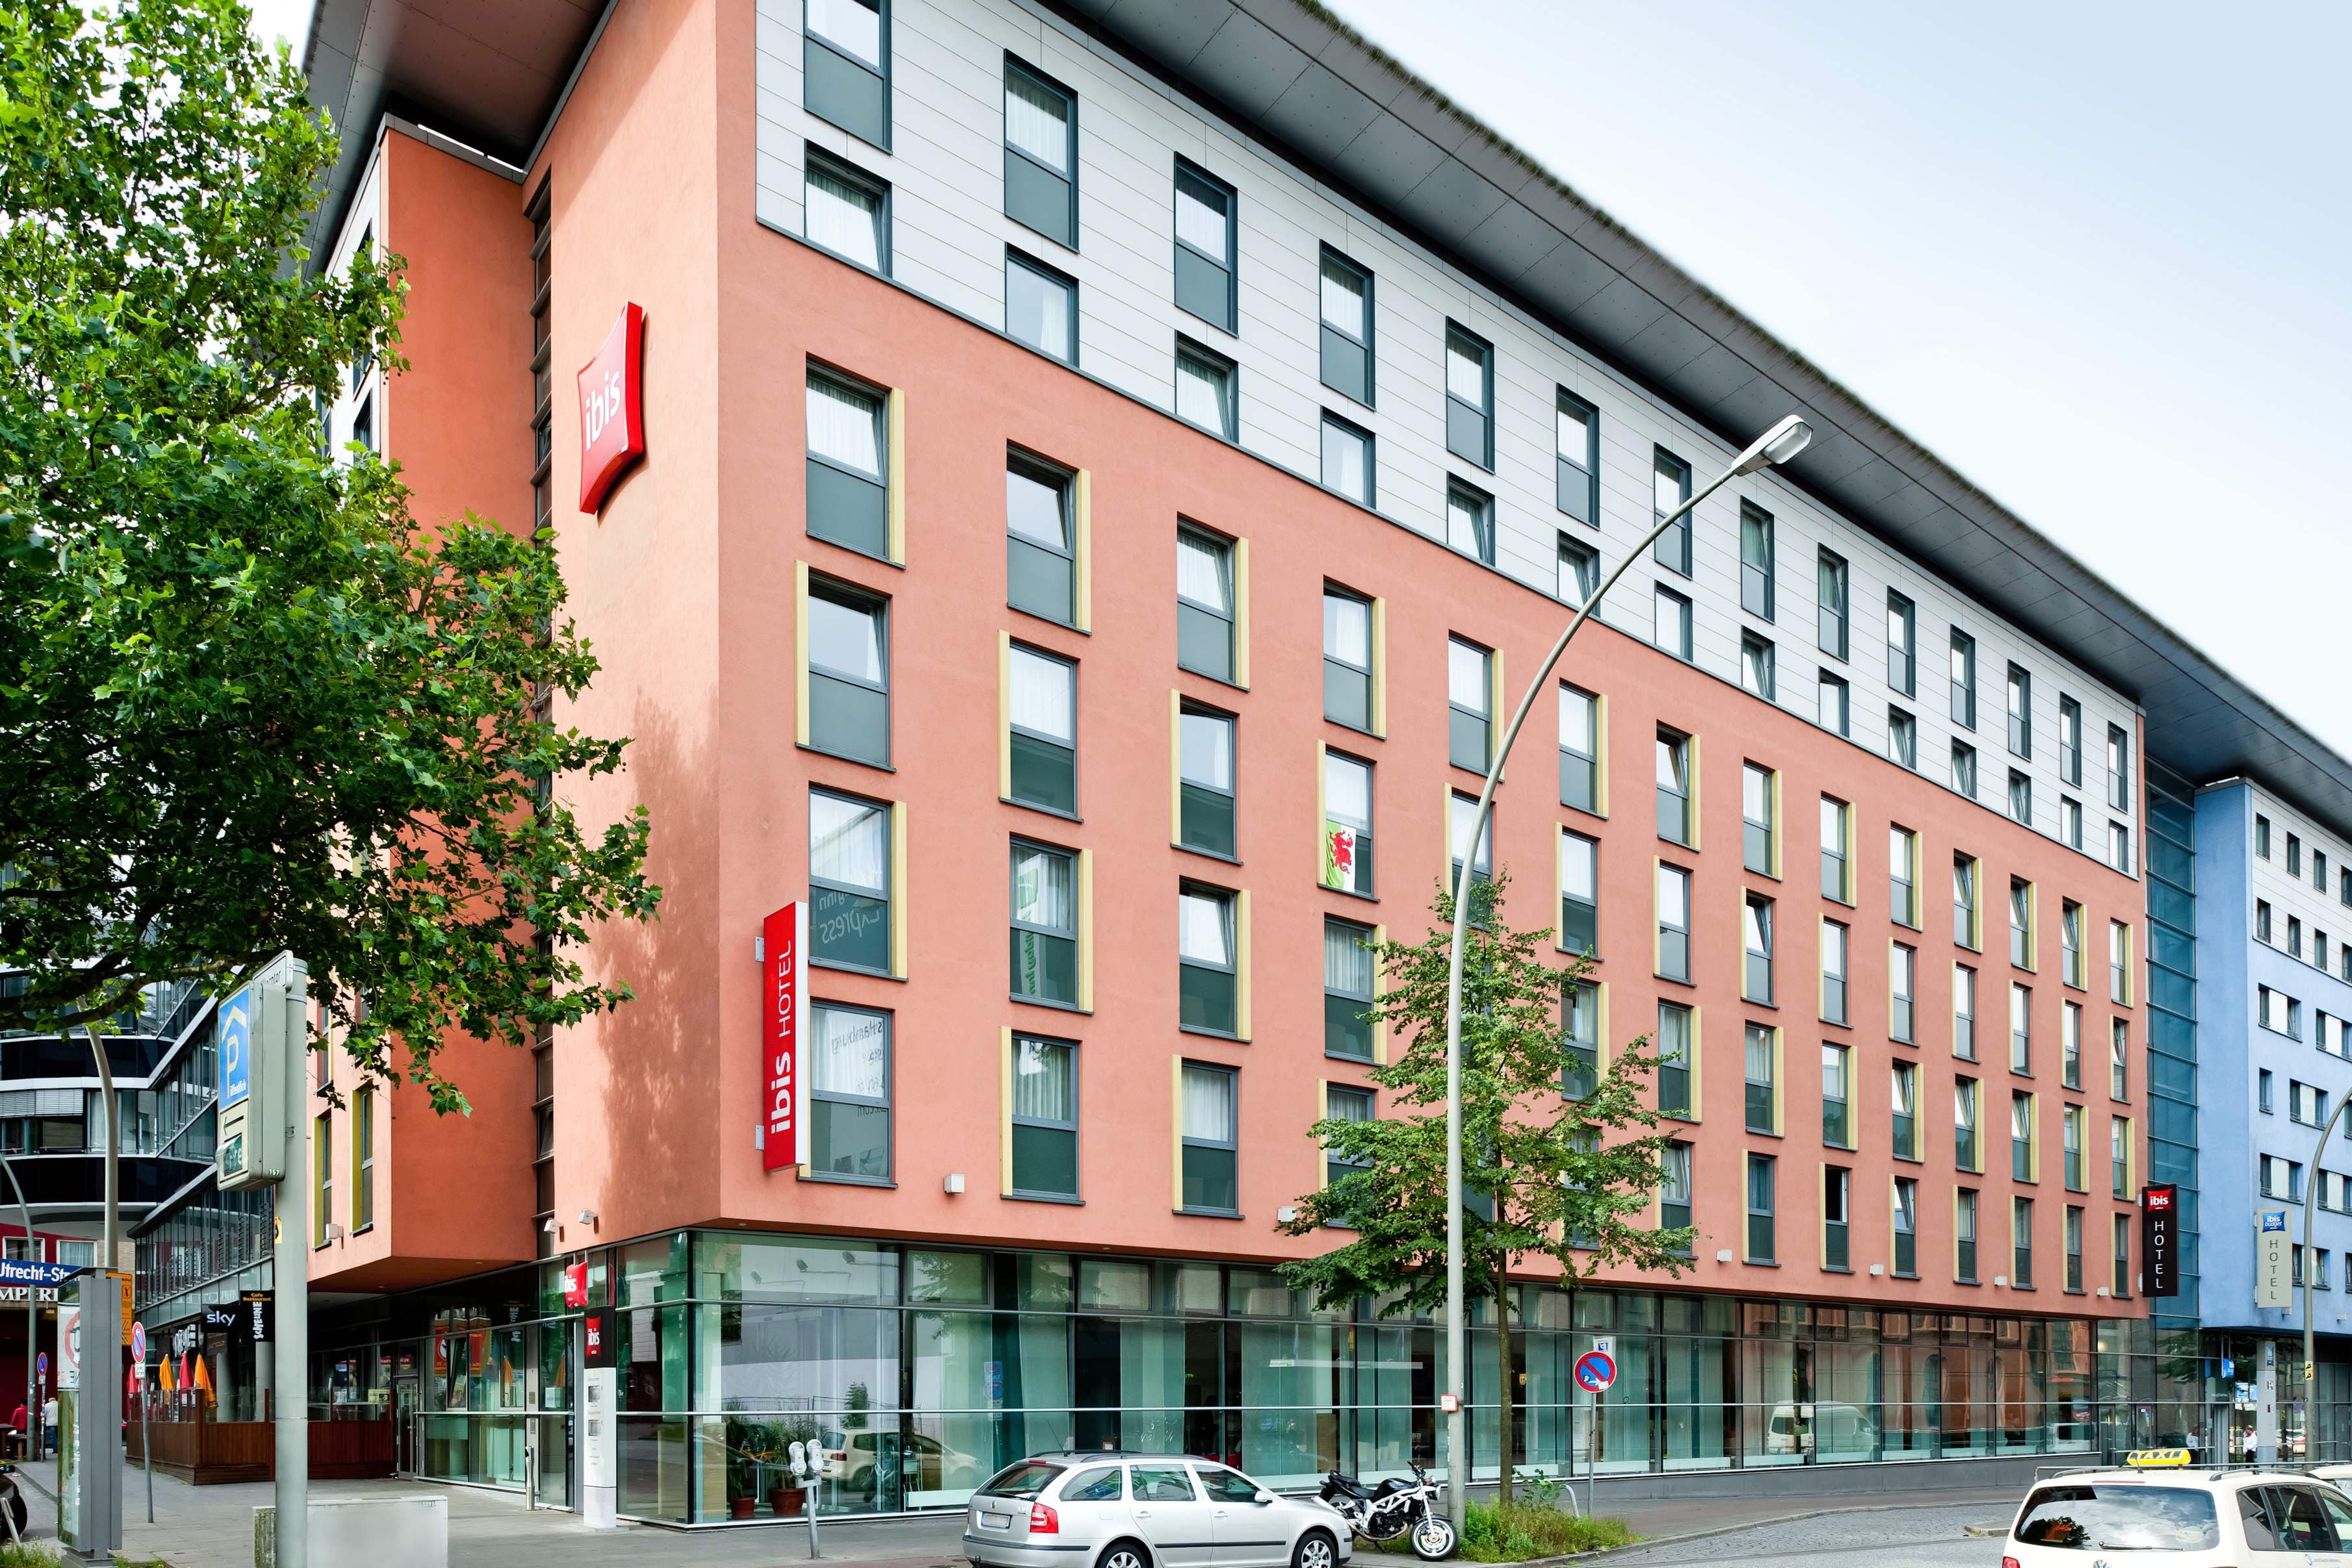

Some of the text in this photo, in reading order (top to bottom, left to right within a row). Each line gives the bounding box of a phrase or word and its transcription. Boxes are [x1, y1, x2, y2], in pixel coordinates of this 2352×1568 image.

[585, 369, 620, 451] ibis
[227, 1035, 238, 1099] P
[771, 940, 791, 1134] ibis HOTEL
[2150, 1195, 2169, 1206] ibis
[2154, 1220, 2165, 1289] HOTEL
[2269, 1239, 2279, 1300] HOTEL
[207, 1310, 236, 1326] sky
[588, 1328, 600, 1346] ibis
[2133, 1450, 2175, 1460] TAXI
